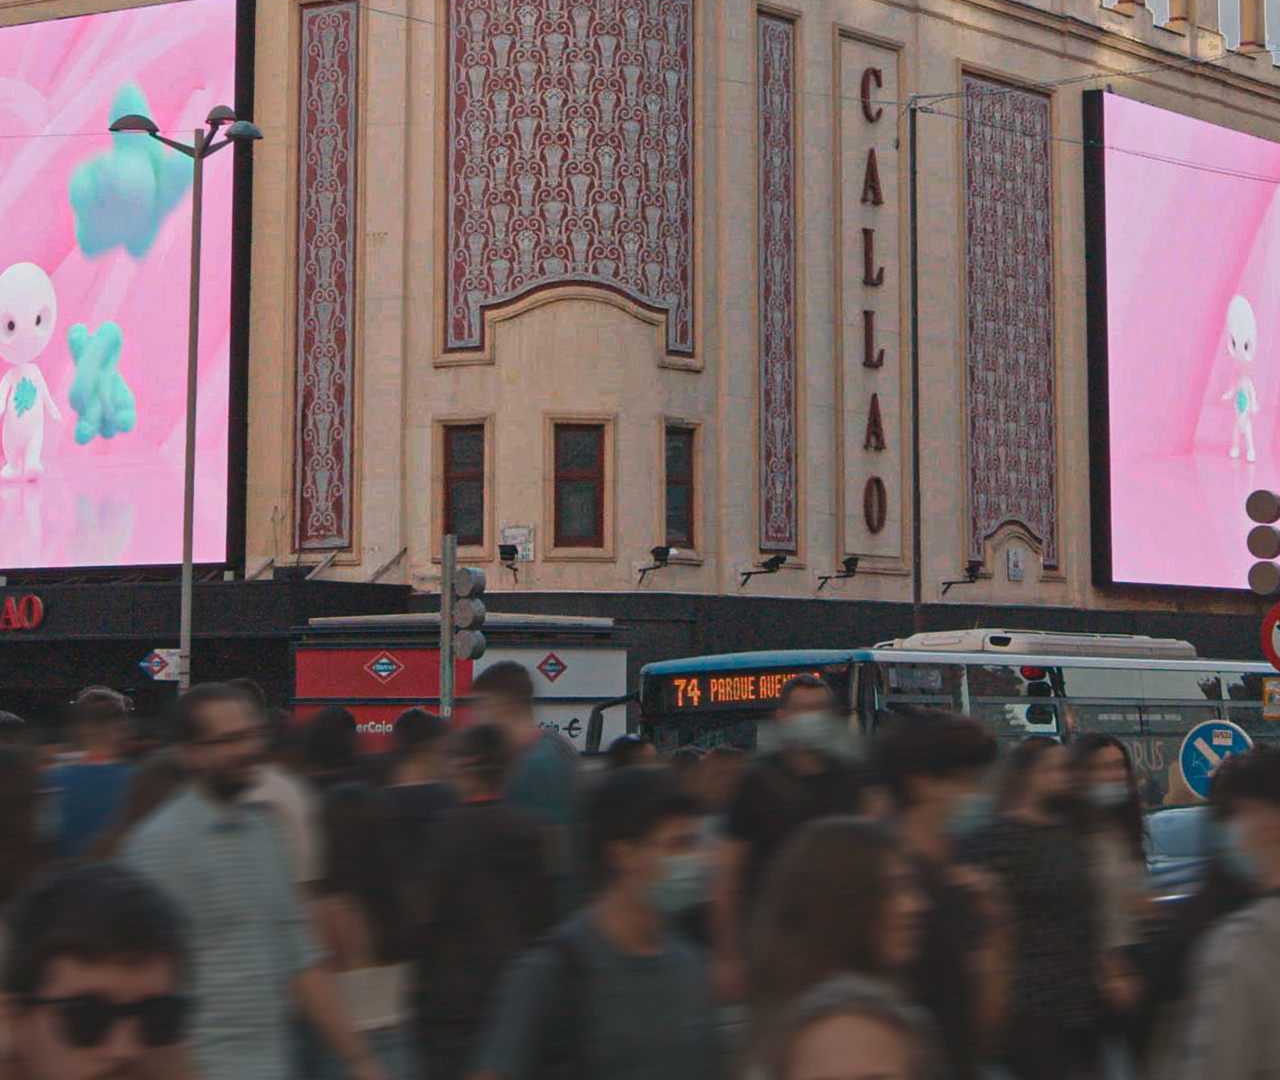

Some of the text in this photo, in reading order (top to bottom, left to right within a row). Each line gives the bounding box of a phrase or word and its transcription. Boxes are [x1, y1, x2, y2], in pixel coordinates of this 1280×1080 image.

[860, 67, 888, 534] CALLAO
[674, 678, 702, 707] 74
[710, 676, 756, 702] PARQUE
[355, 720, 394, 735] erCaja
